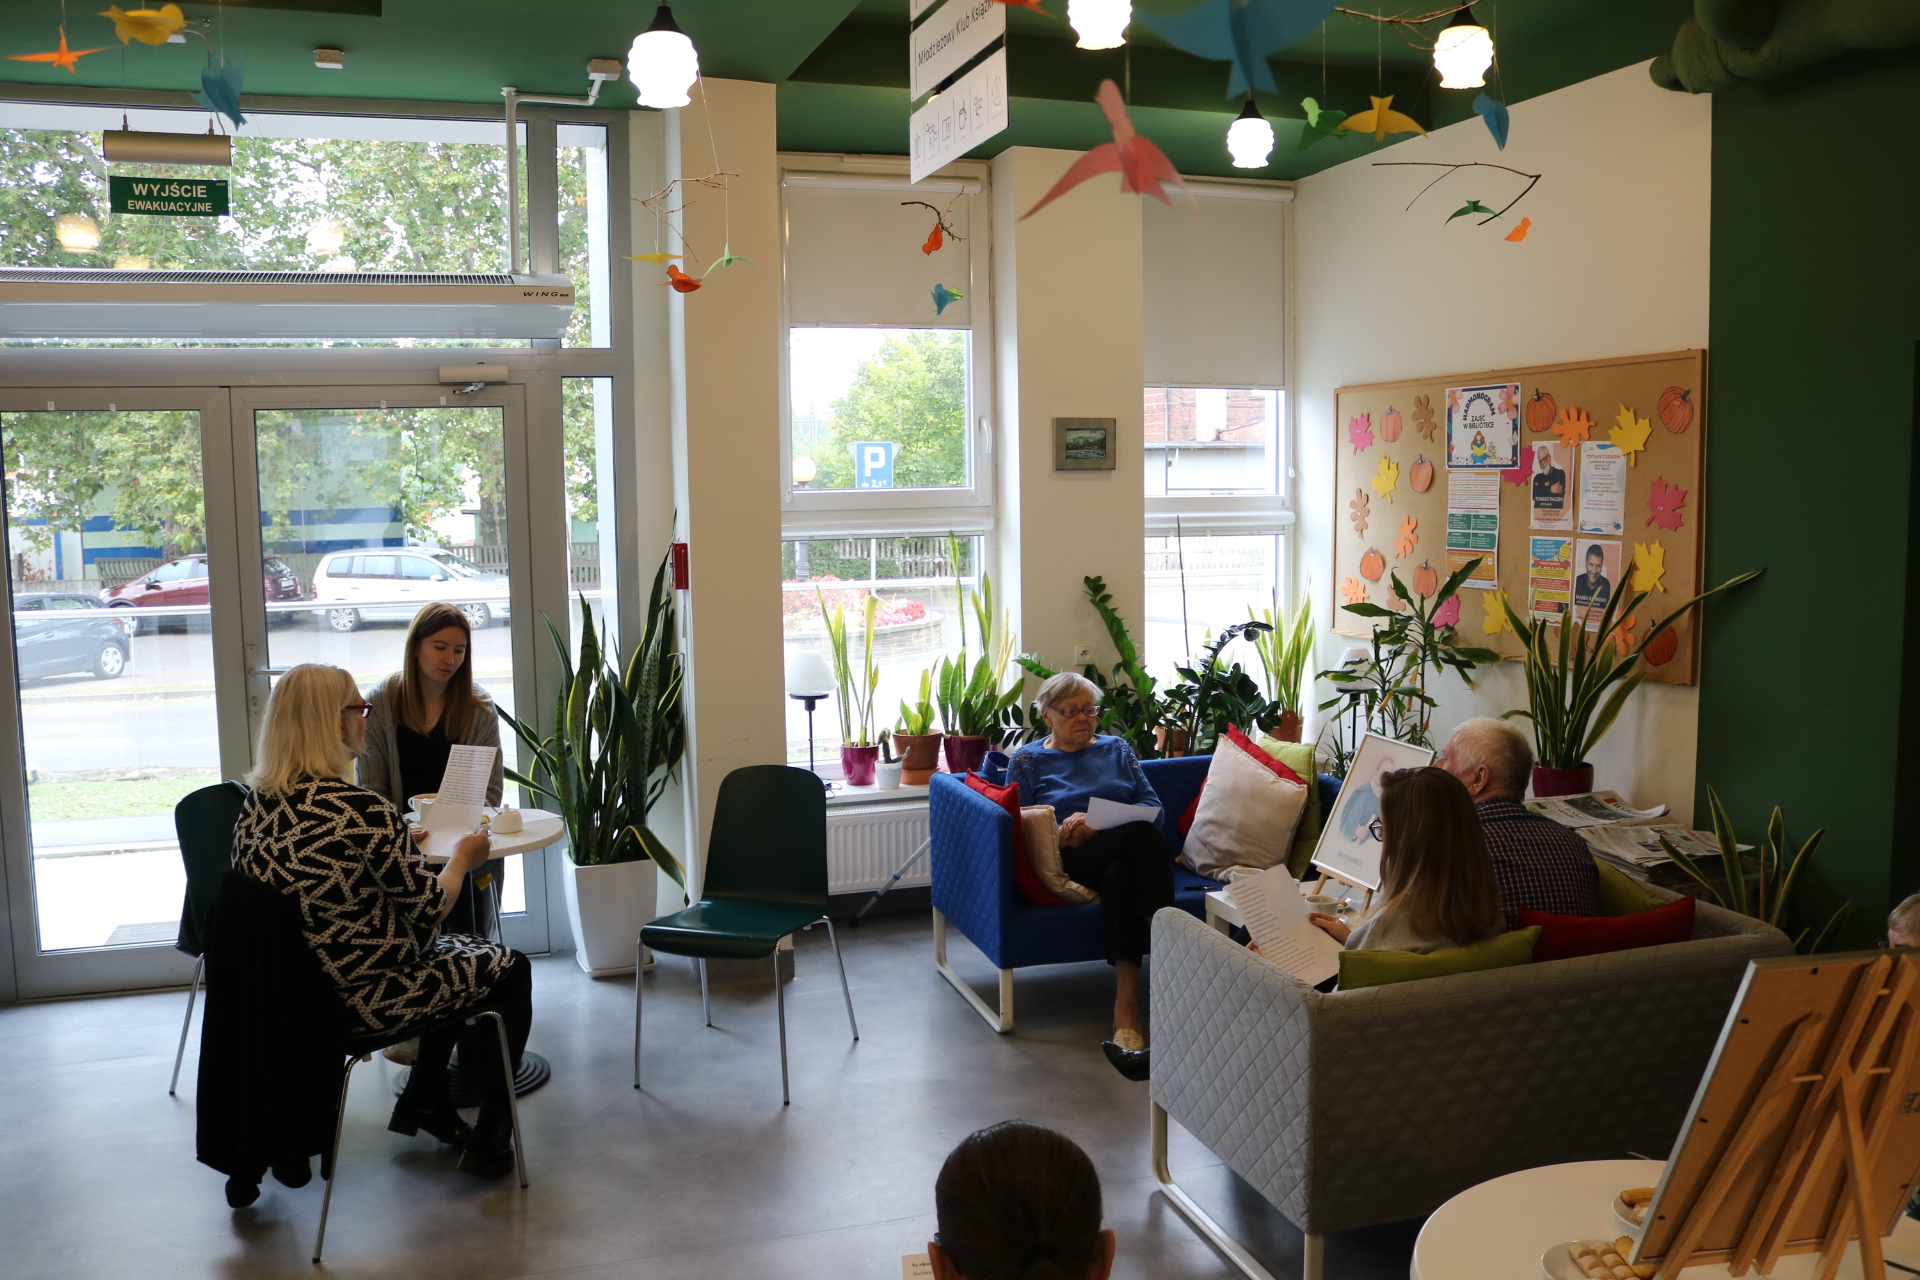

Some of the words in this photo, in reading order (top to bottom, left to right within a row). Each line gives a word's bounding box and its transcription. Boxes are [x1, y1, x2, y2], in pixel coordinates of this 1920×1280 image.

[918, 27, 955, 67] Młodzieżowy
[956, 12, 970, 36] Klub
[132, 182, 207, 198] WYJŚCIE
[127, 200, 213, 212] EWAKUACYJNE
[1463, 392, 1496, 421] HARMONOGRAM
[864, 446, 885, 477] P
